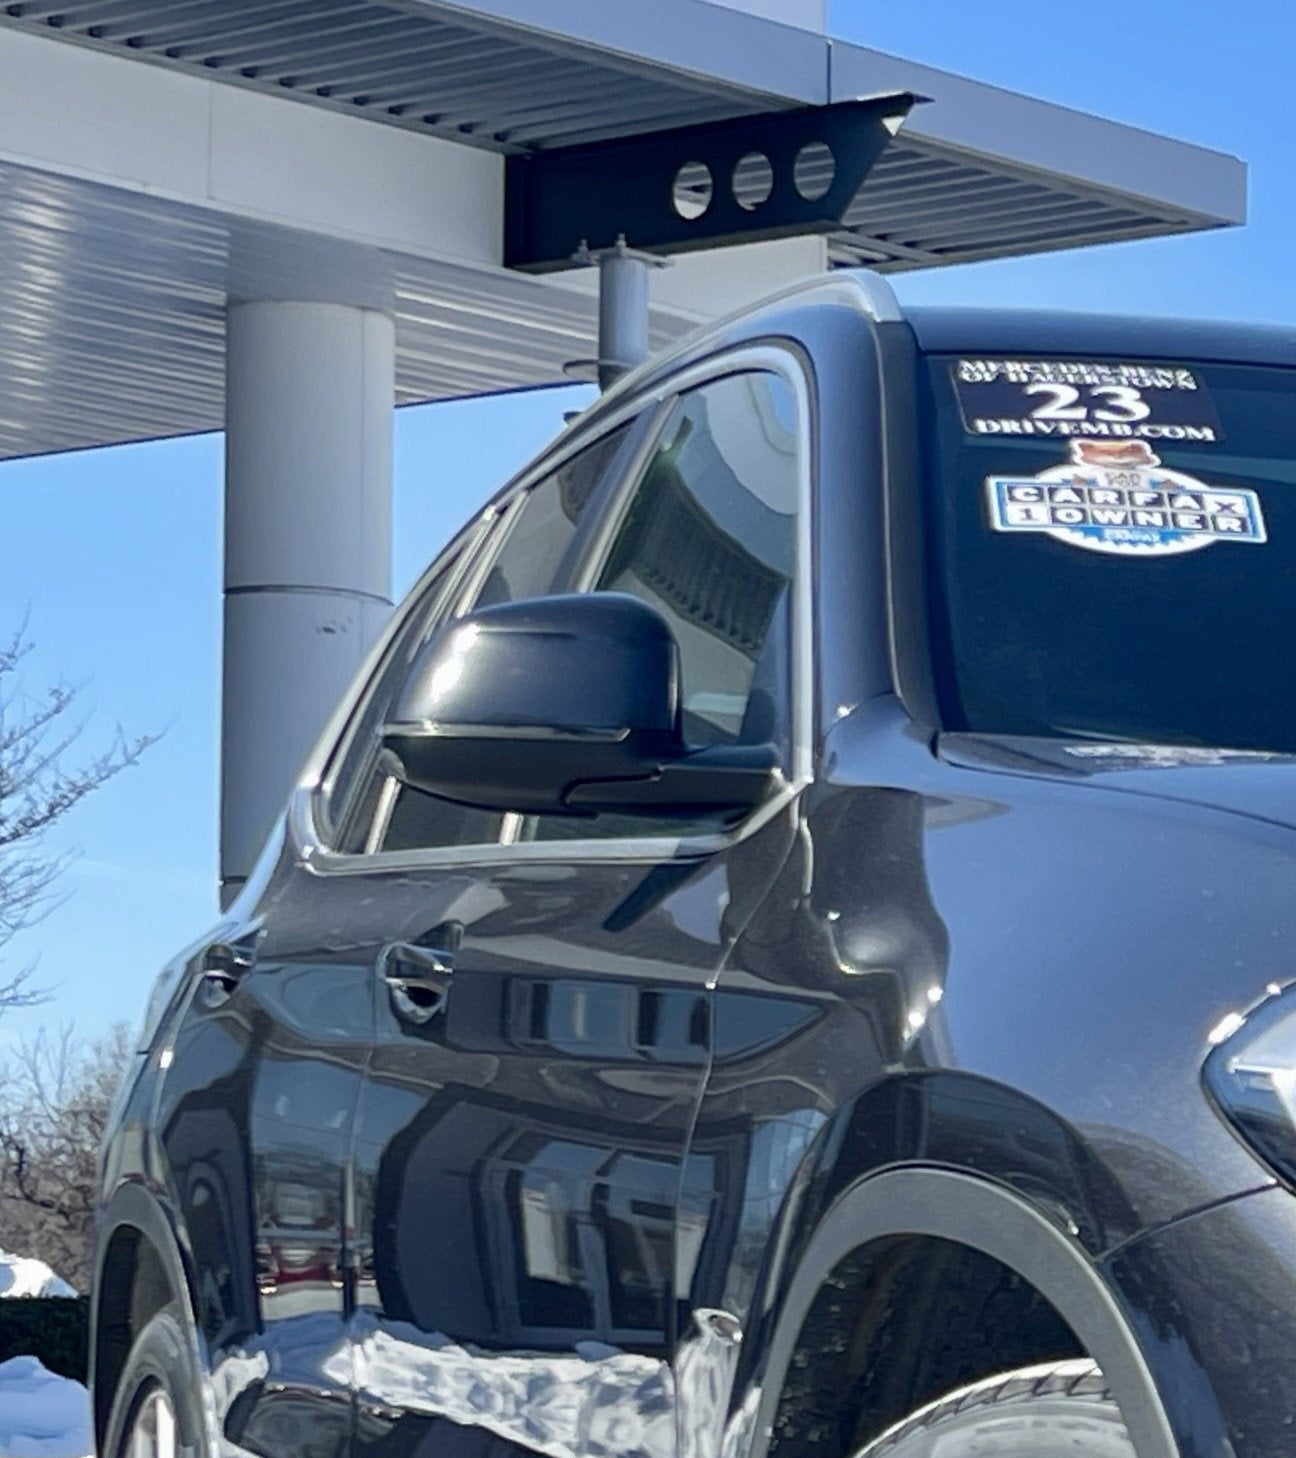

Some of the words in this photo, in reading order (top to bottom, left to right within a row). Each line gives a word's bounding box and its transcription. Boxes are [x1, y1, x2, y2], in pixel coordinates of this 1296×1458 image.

[1023, 382, 1151, 422] 23
[974, 419, 1216, 442] DRIVEMB.COM
[1010, 486, 1244, 514] CARFAX
[1054, 507, 1245, 534] OWNER
